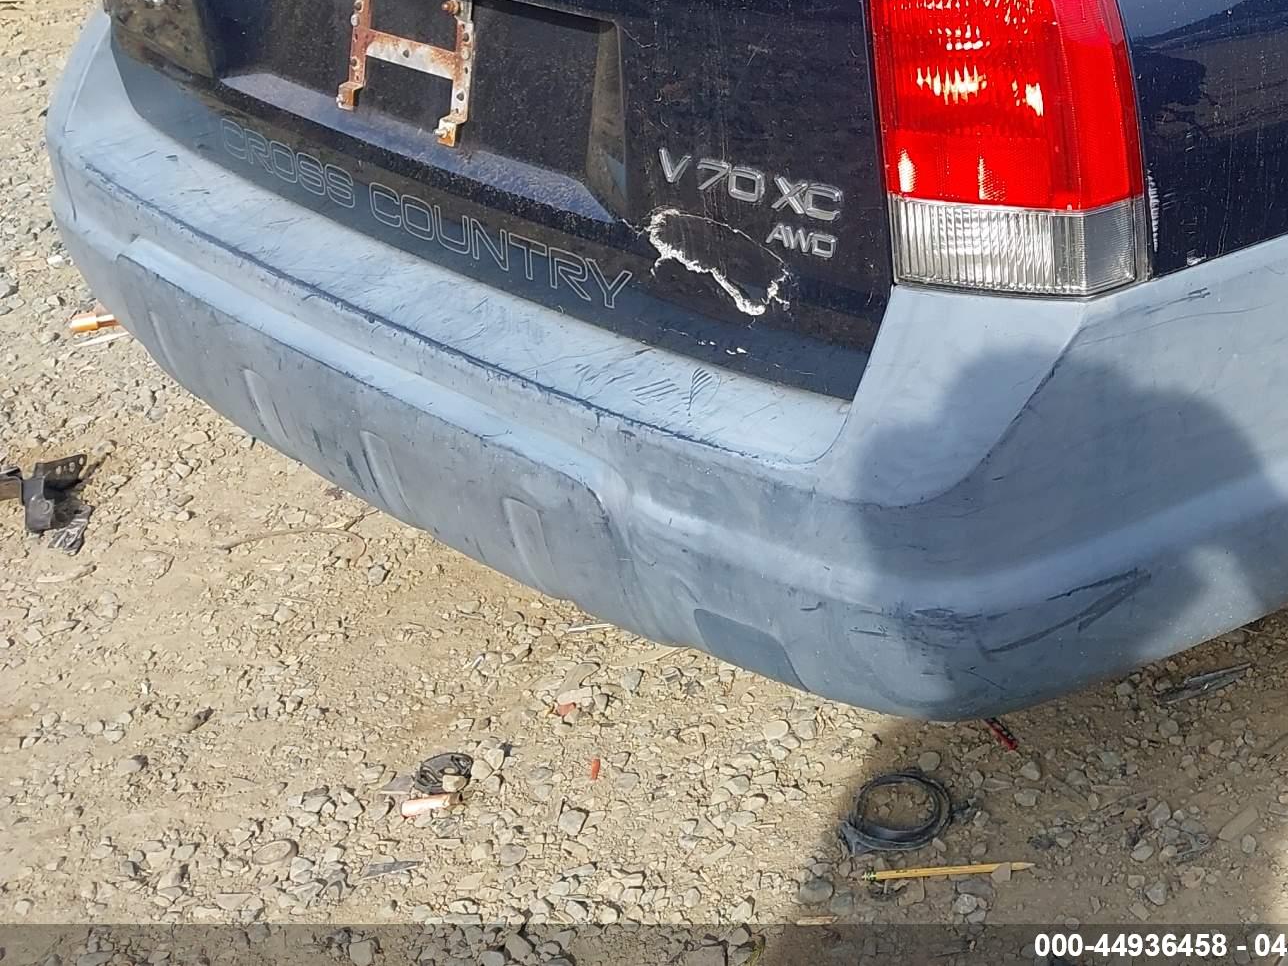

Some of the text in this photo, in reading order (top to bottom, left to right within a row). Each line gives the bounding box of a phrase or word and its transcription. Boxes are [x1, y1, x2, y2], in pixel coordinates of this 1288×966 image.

[220, 118, 633, 309] CROSS COUNTRY
[771, 173, 844, 221] XC
[765, 222, 839, 259] AWD
